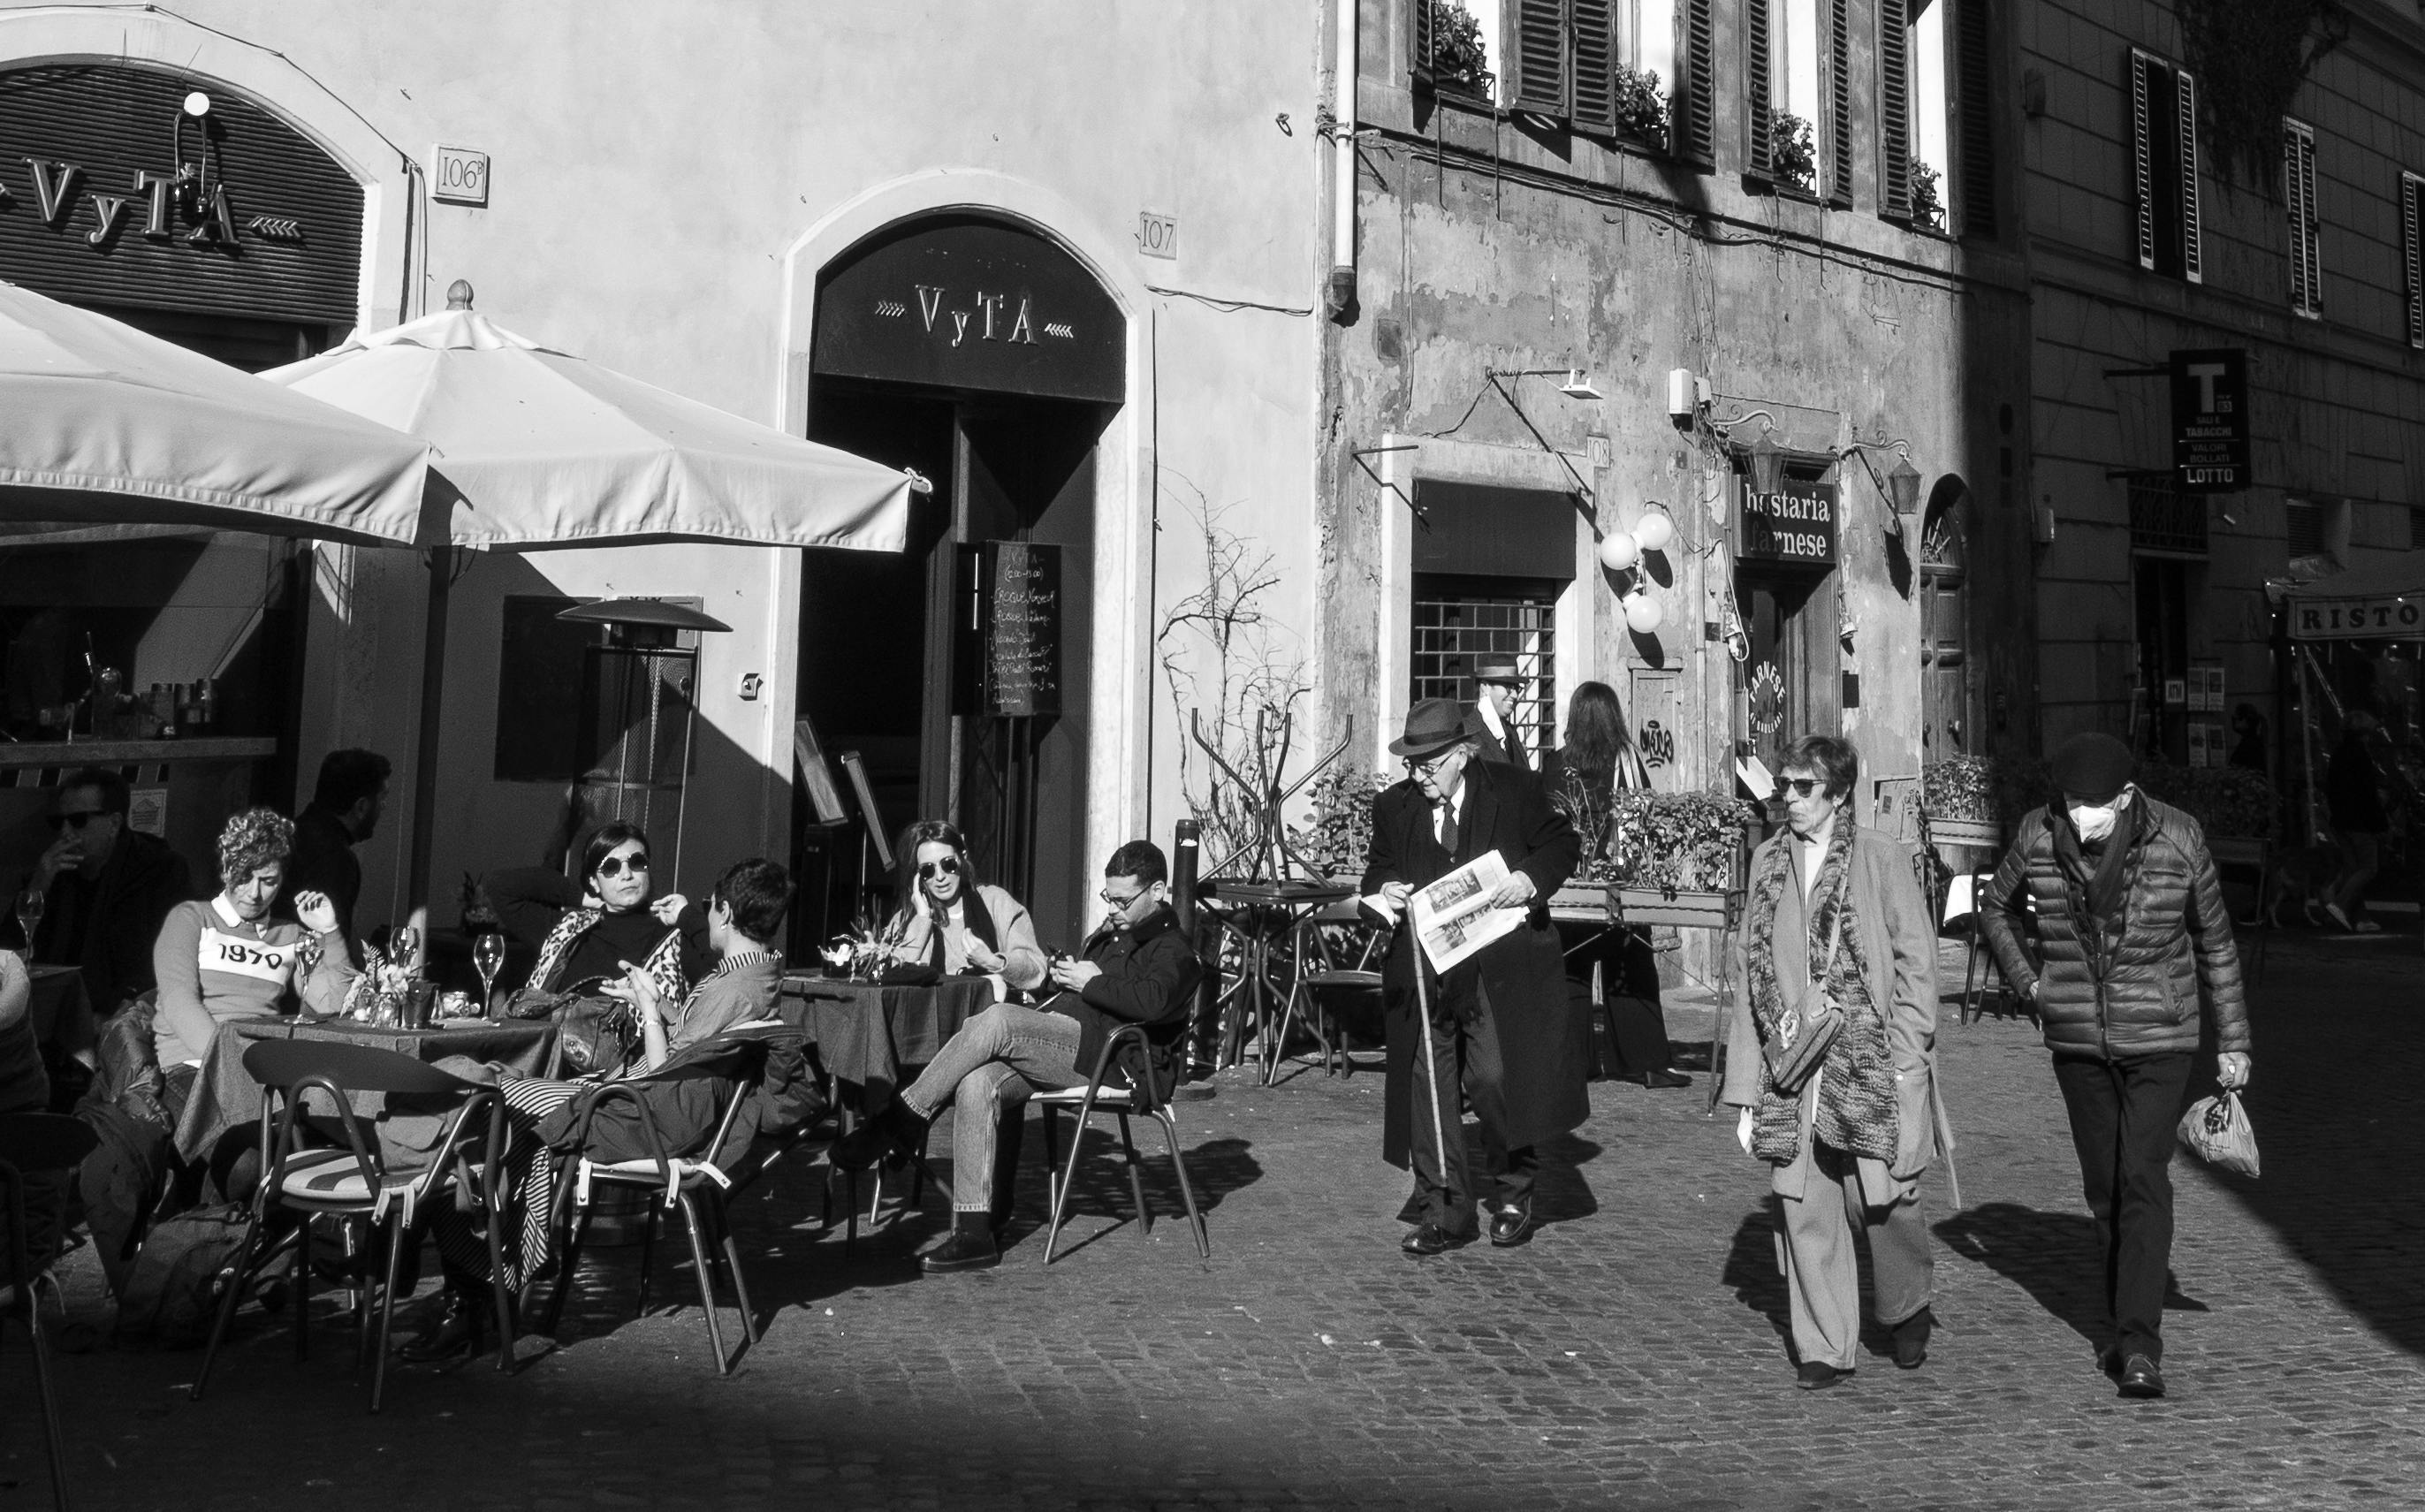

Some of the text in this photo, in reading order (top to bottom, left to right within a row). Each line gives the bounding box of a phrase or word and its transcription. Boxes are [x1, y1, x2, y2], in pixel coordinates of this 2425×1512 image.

[22, 156, 240, 245] VyTA
[1141, 219, 1174, 251] 107
[916, 285, 1038, 348] VyTA
[2186, 362, 2226, 413] T
[2185, 427, 2232, 437] TABACCHI
[2189, 453, 2230, 464] BOLLATI
[2192, 443, 2227, 452] VALORI
[2186, 468, 2234, 484] LOTTO
[1750, 520, 1827, 558] farnese
[2301, 604, 2419, 629] RISTO
[1749, 660, 1786, 704] FARNESE
[217, 943, 283, 970] 1970
